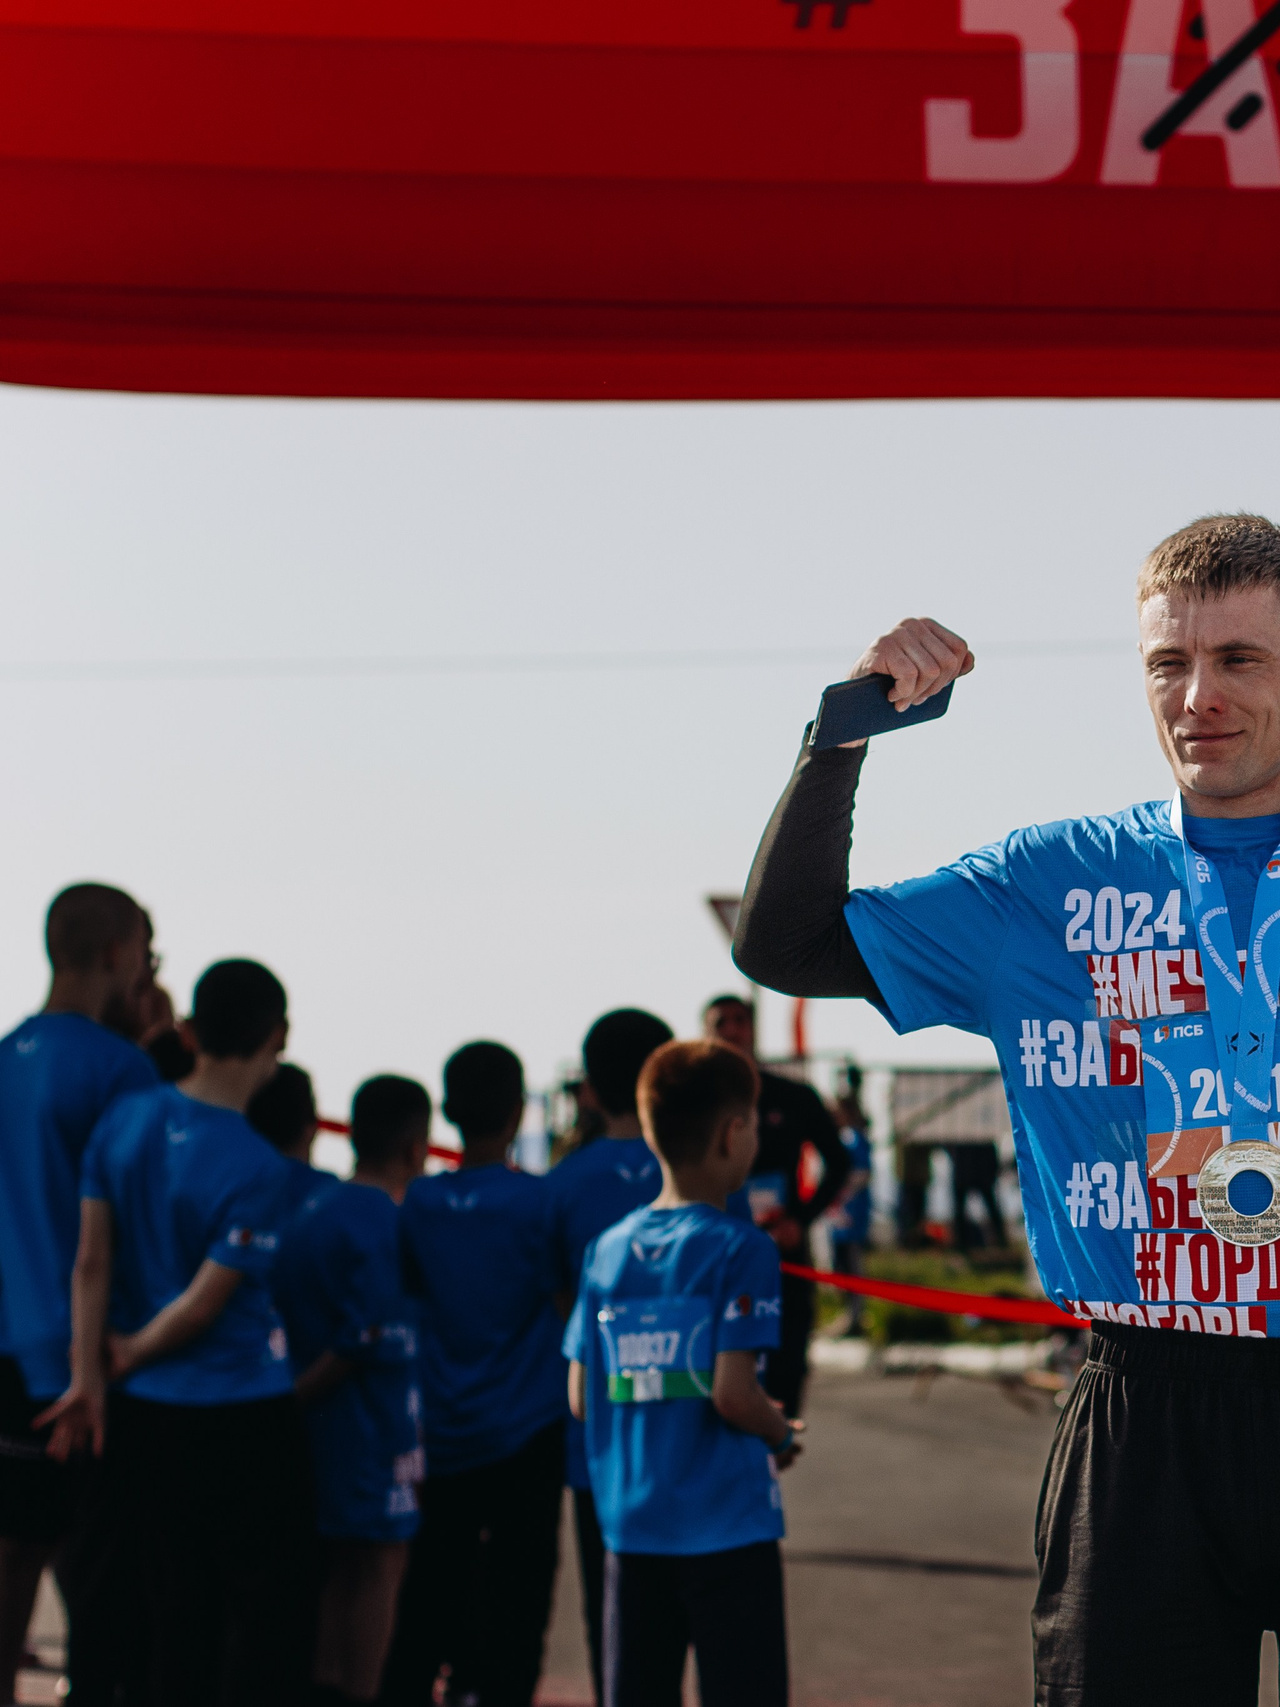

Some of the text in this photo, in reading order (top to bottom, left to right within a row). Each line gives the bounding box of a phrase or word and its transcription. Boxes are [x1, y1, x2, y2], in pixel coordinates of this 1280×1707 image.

[1064, 887, 1185, 952] 2024
[1019, 1018, 1143, 1088] #ЗАБ
[1173, 1024, 1204, 1039] ПСБ
[1066, 1160, 1203, 1230] #ЗАБЕ
